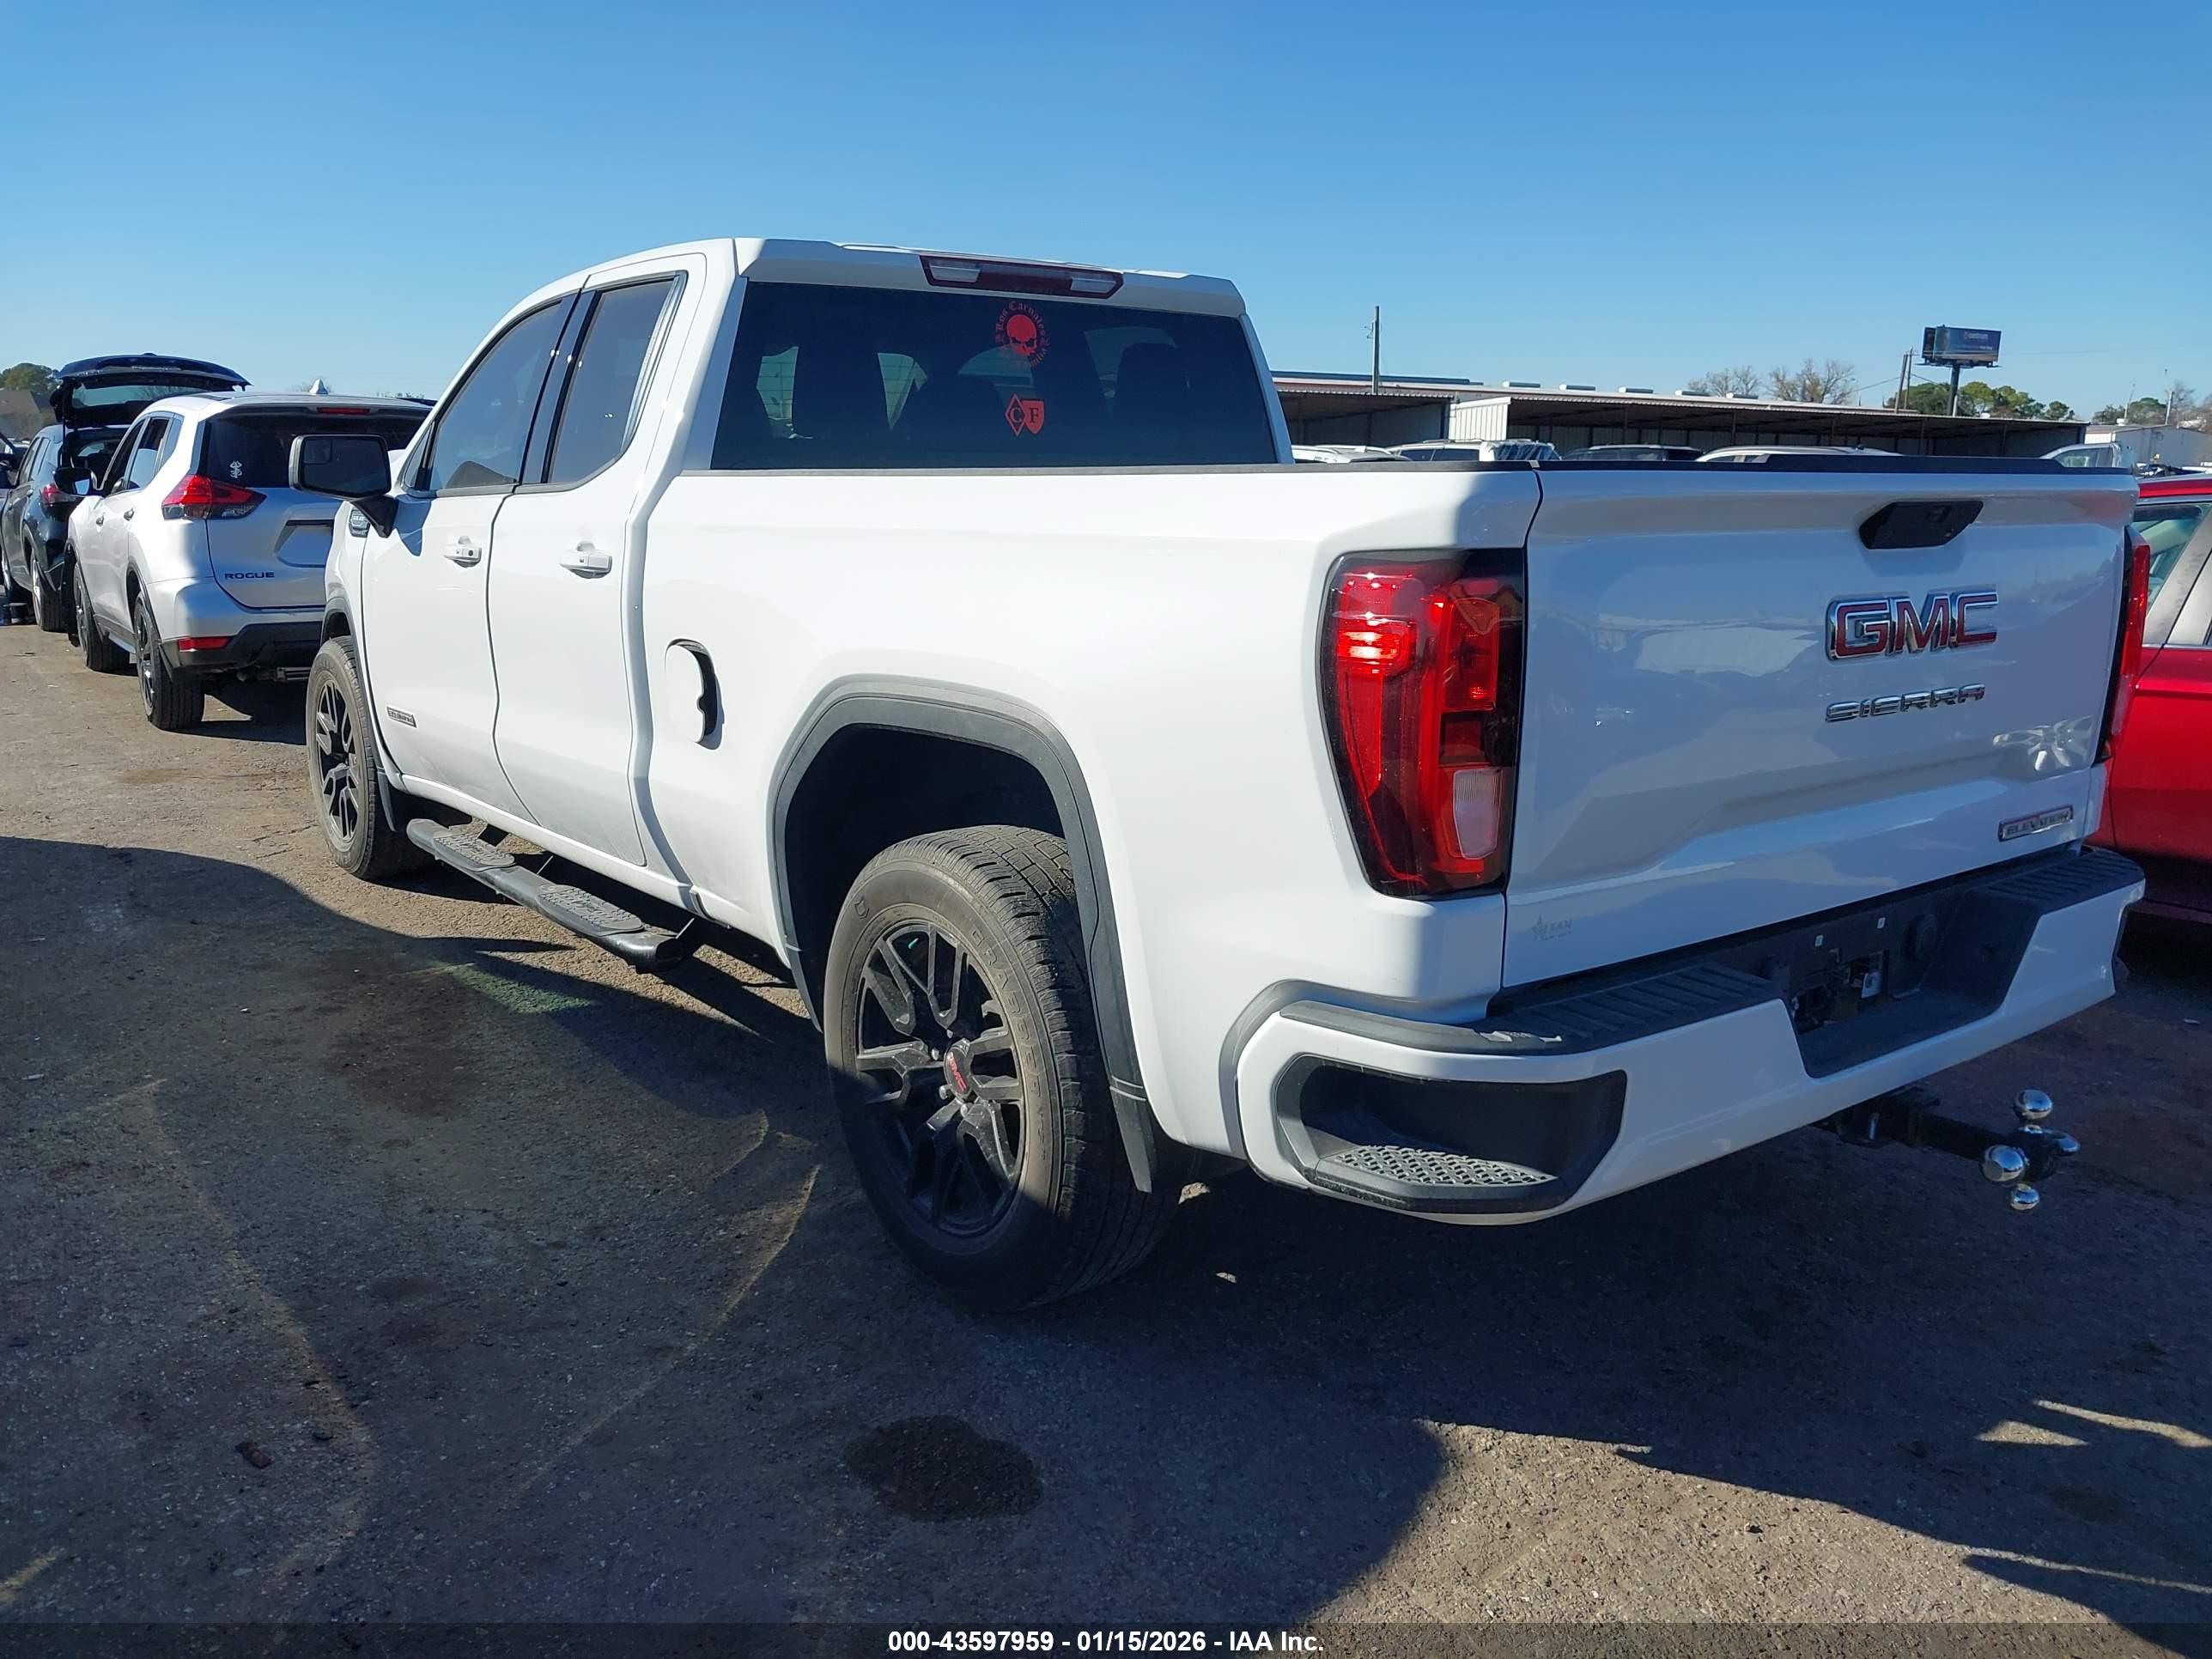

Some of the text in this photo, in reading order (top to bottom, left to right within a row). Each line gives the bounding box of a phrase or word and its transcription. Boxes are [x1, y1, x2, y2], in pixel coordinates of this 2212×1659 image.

[1826, 591, 1999, 660] GMC
[1825, 684, 1985, 723] SIERRA
[970, 927, 1042, 1097] GRABBER
[946, 1051, 967, 1092] GMC
